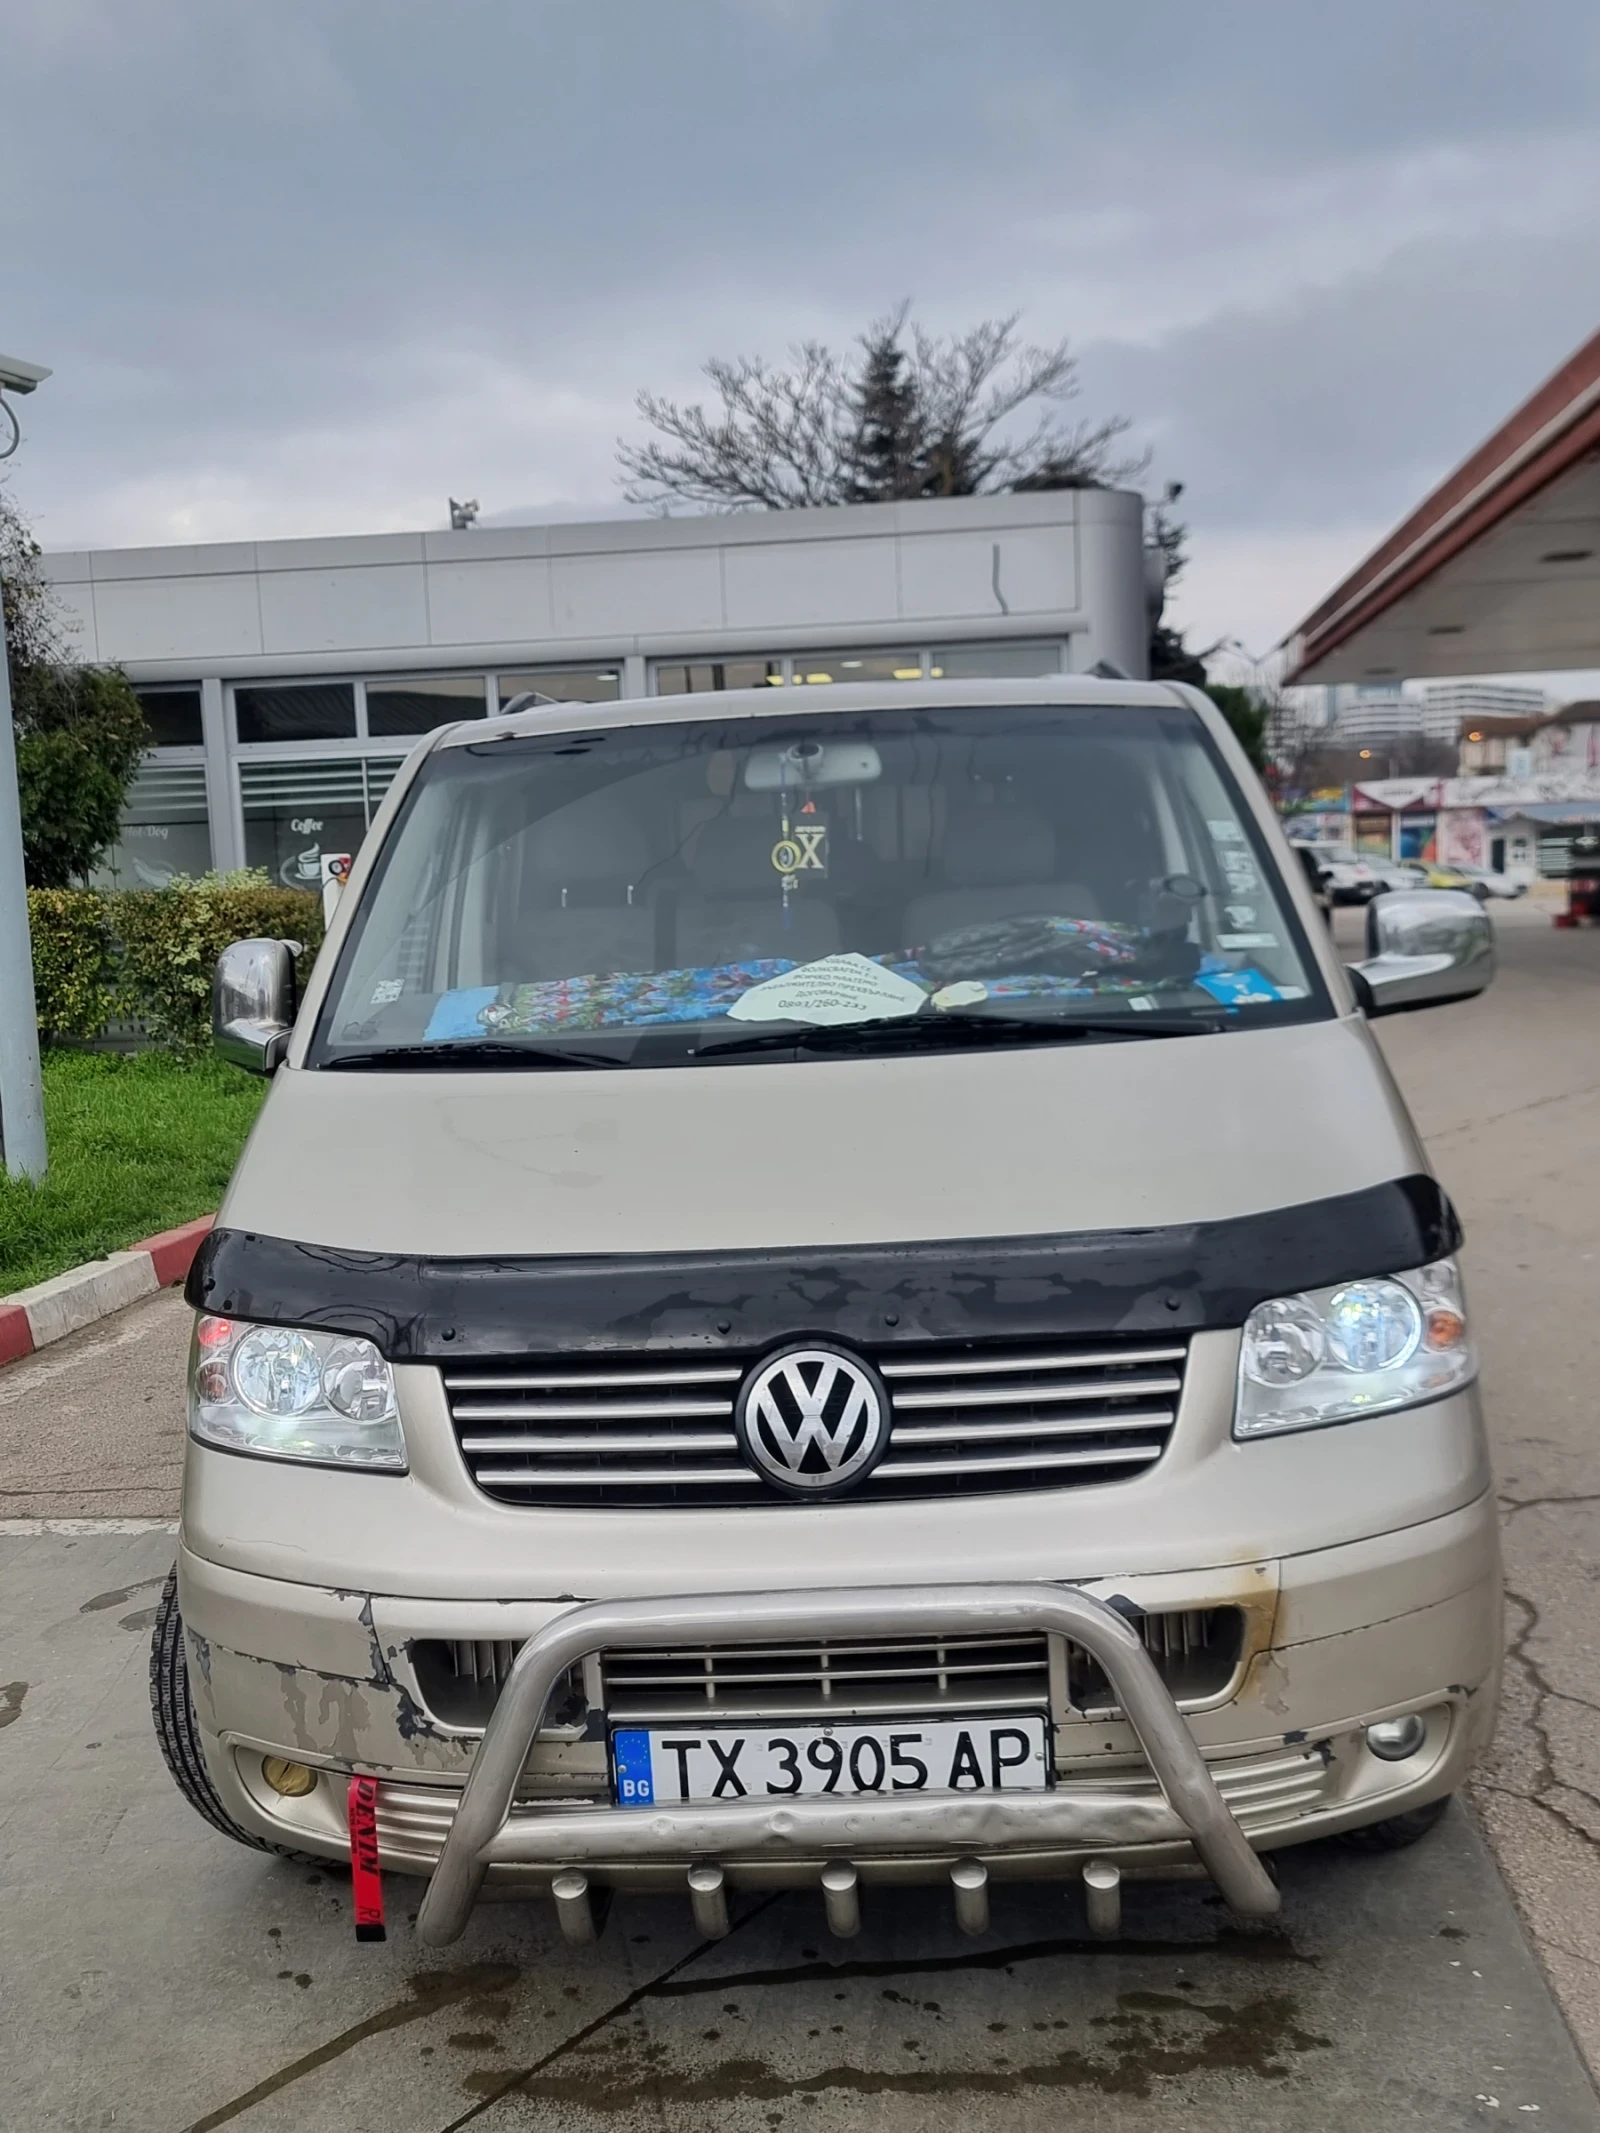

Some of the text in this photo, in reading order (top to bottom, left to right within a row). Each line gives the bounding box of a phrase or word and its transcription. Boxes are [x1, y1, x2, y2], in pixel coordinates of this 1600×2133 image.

[291, 818, 324, 835] Coffee
[746, 1351, 880, 1487] VW
[623, 1779, 650, 1797] BG
[662, 1728, 1030, 1799] TX 3905 AP
[356, 1779, 378, 1877] DENIM
